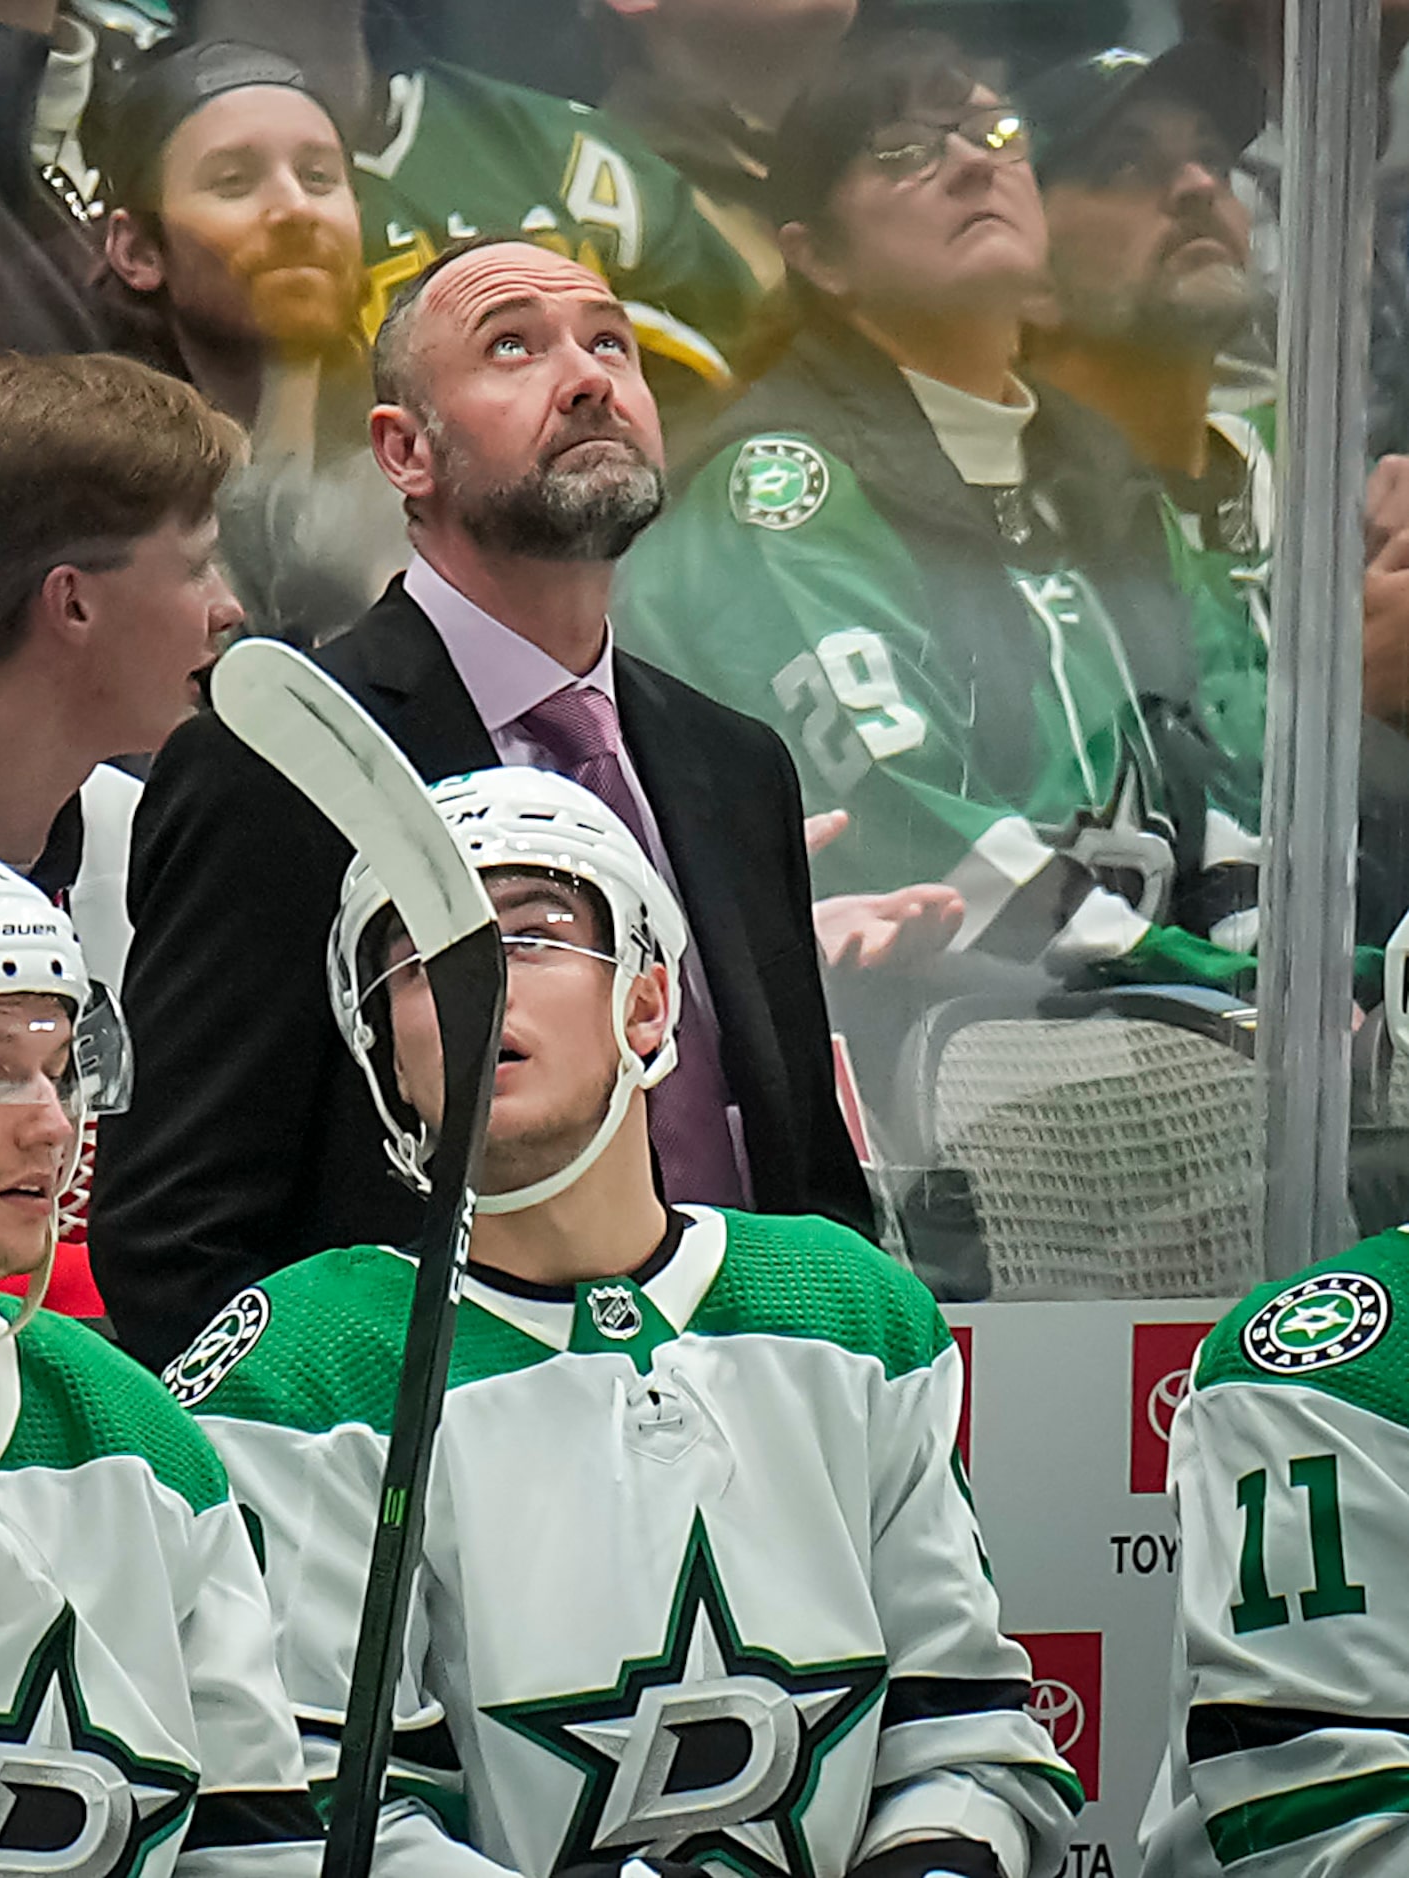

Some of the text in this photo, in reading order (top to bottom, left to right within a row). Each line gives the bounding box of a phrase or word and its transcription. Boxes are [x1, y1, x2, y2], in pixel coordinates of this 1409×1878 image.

[563, 134, 639, 270] A
[771, 626, 928, 797] 29
[1252, 1279, 1378, 1366] DALLAS STARS
[1230, 1454, 1367, 1635] 11
